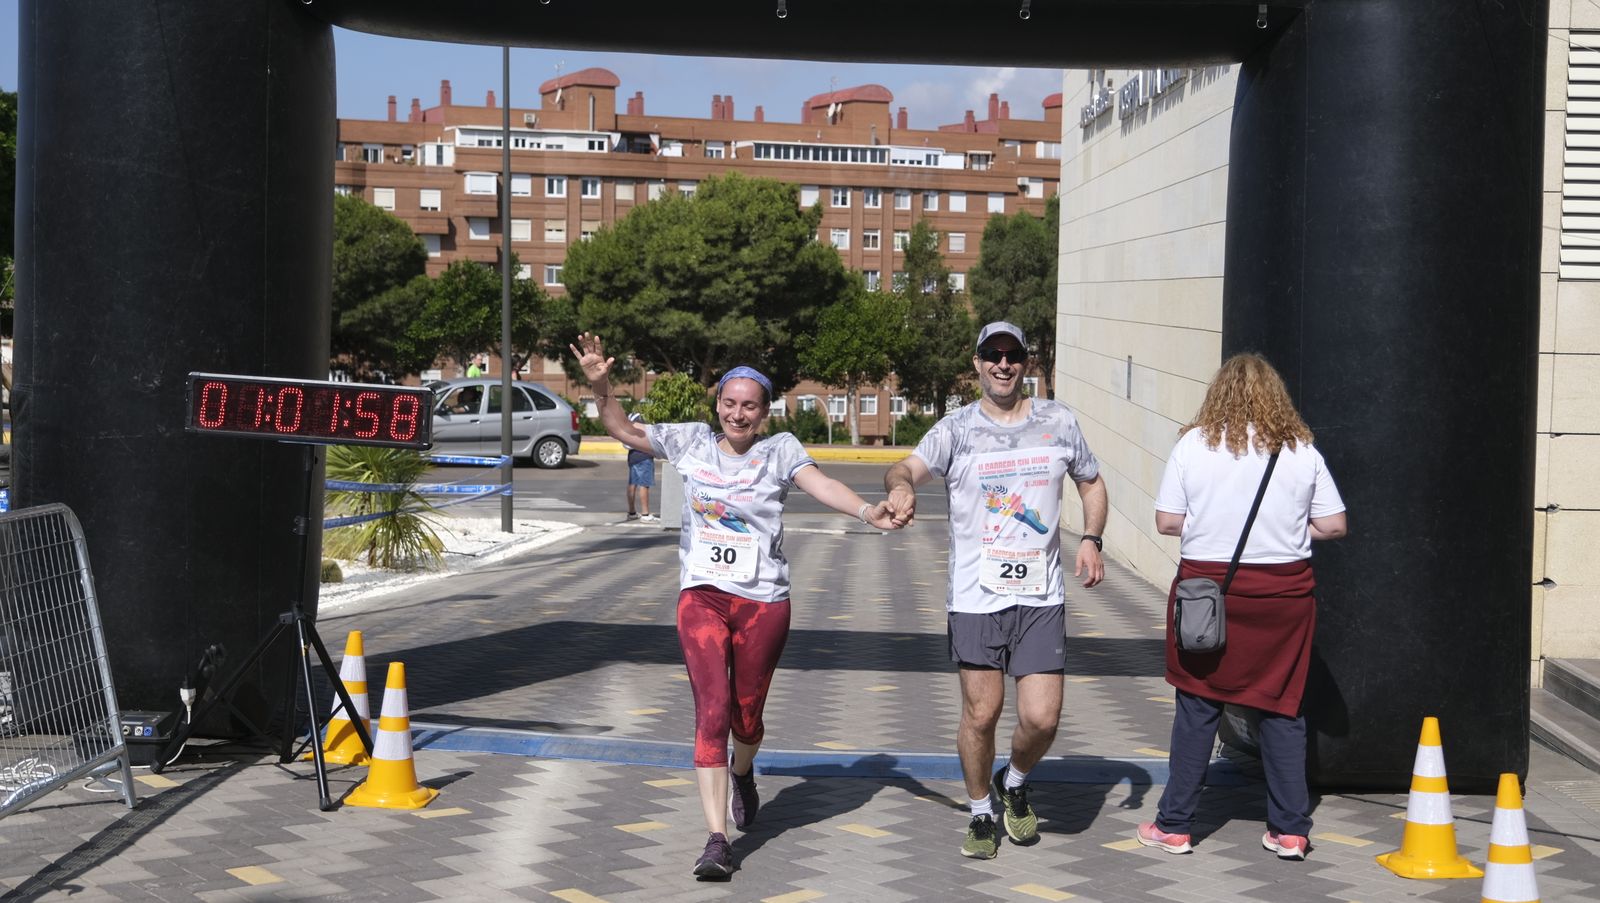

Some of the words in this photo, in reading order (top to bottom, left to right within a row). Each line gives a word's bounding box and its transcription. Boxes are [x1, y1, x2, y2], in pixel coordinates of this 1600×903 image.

[199, 382, 419, 440] 01:01:58
[710, 546, 737, 565] 30
[999, 563, 1028, 579] 29
